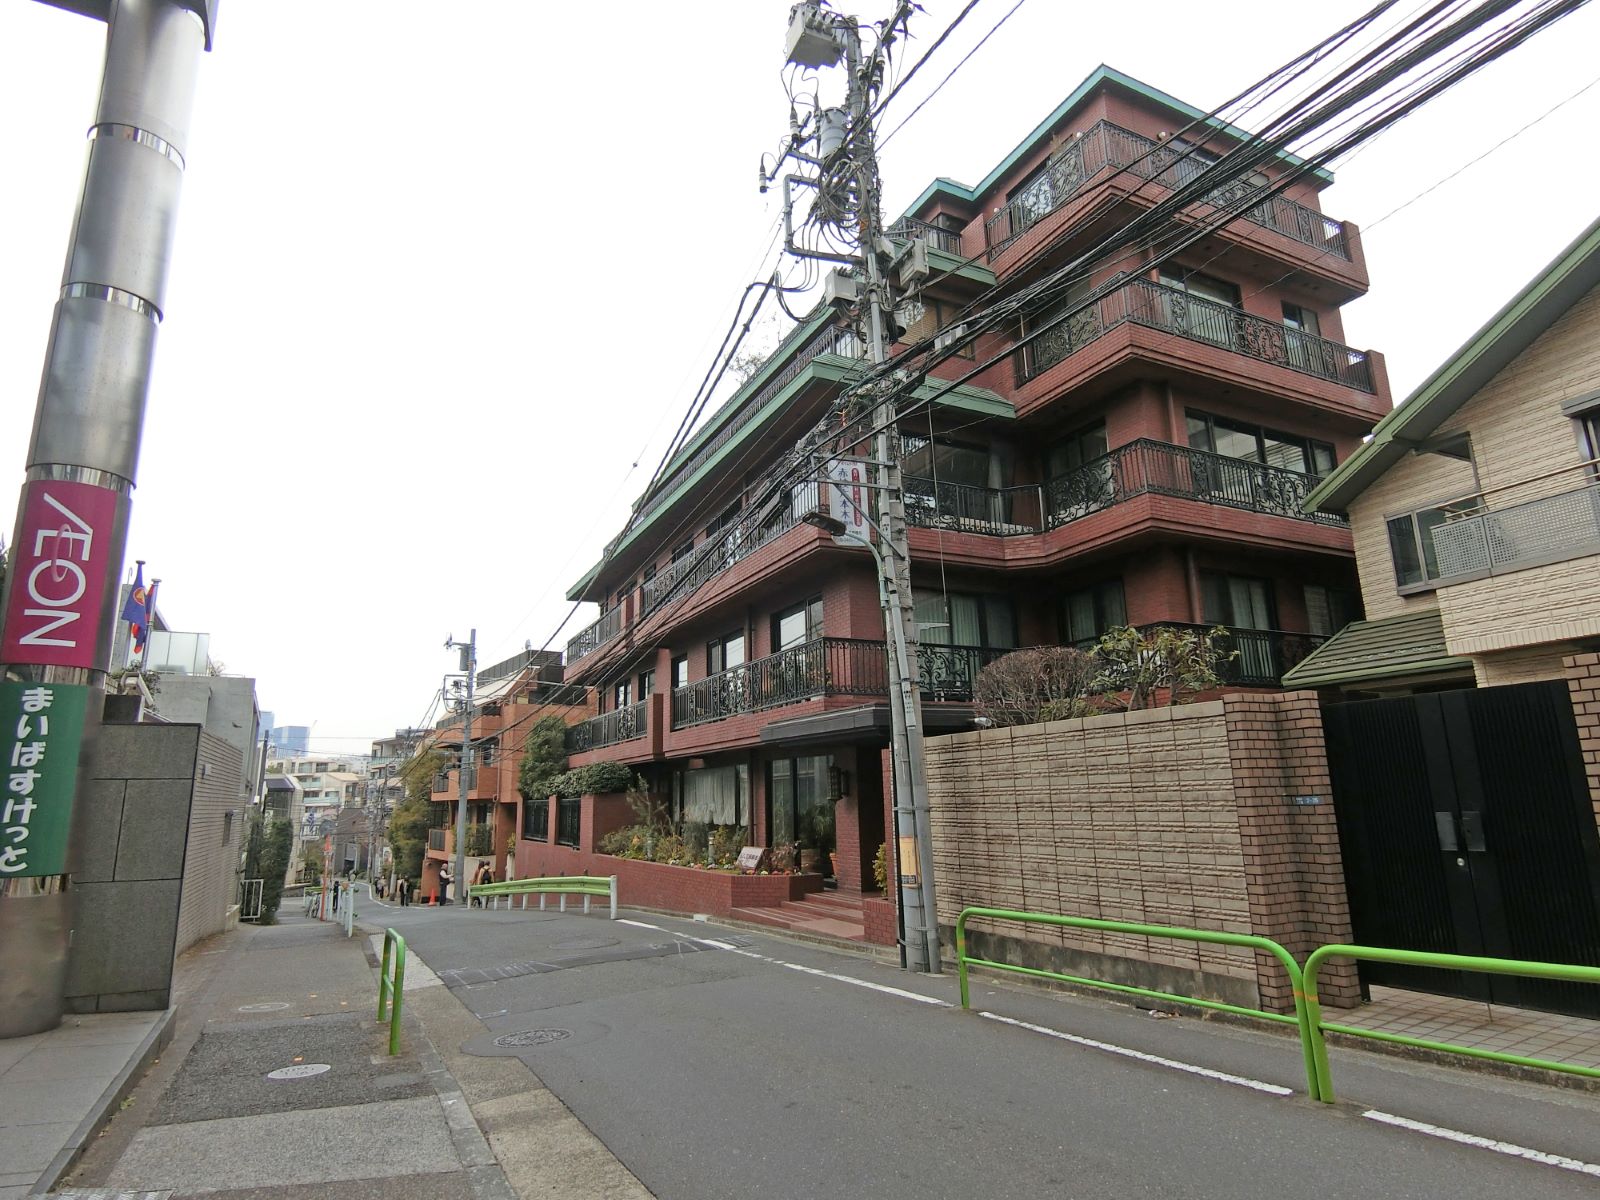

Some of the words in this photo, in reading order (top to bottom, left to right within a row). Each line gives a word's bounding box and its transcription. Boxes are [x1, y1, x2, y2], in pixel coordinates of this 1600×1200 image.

[19, 492, 94, 648] AEON
[0, 686, 54, 873] まいばすけっと
